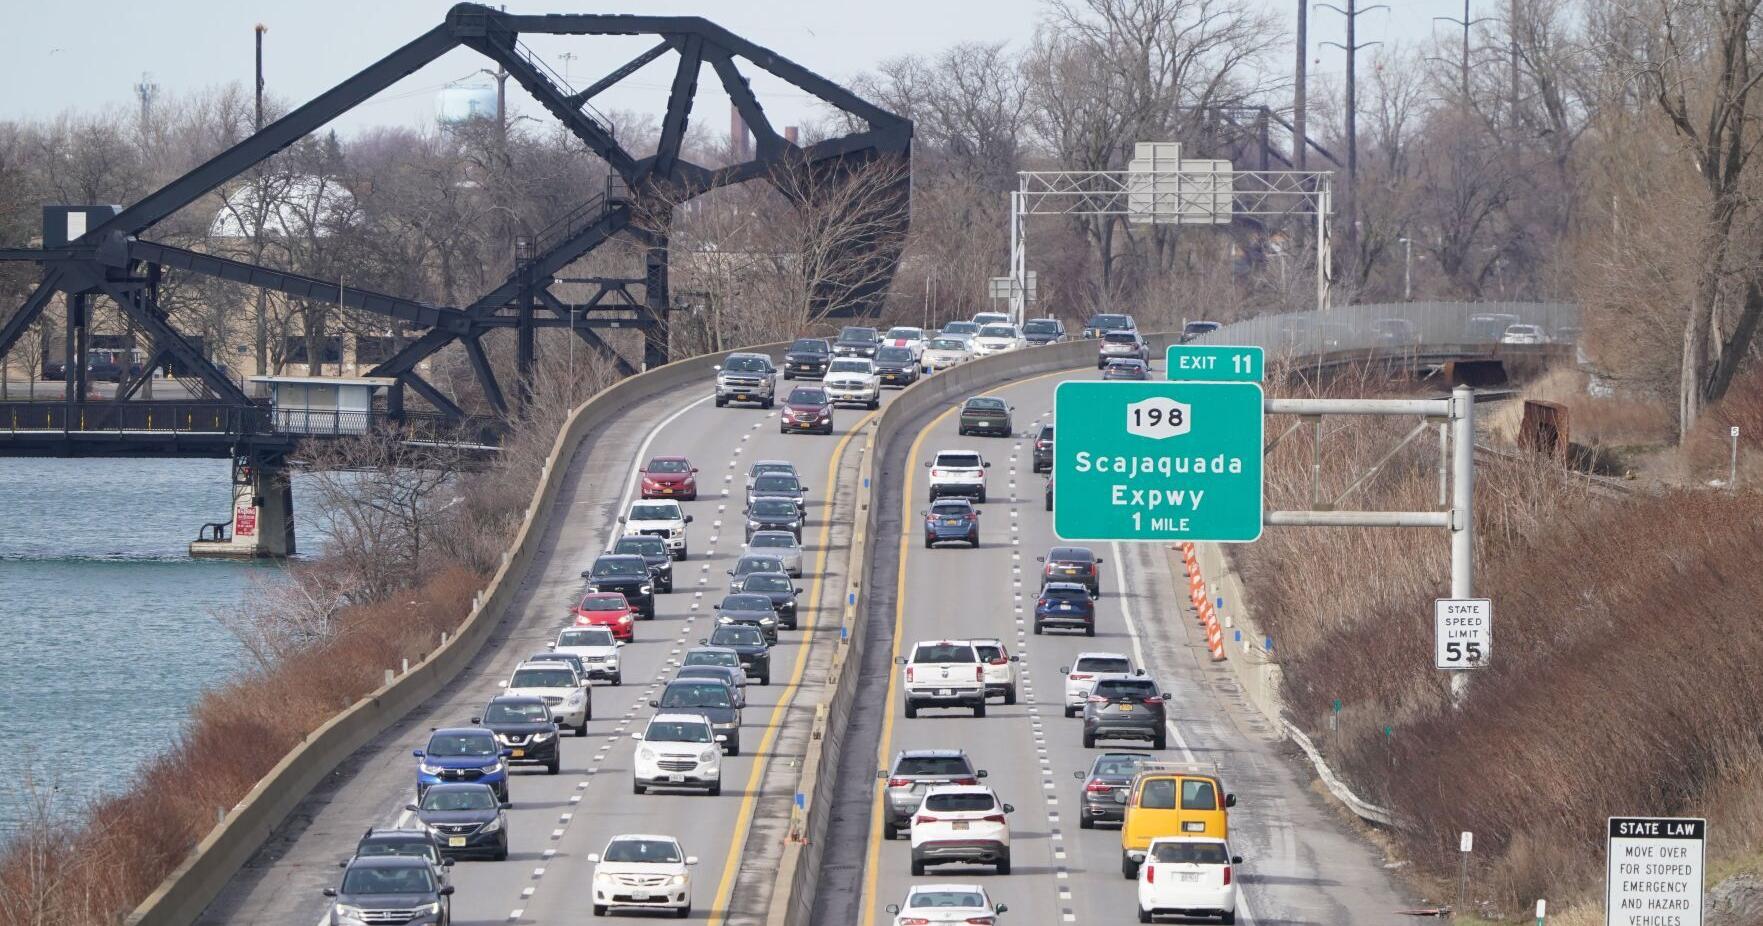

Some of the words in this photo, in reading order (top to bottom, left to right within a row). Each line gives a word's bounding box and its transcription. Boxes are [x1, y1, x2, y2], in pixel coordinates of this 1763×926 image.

[1180, 356, 1216, 370] EXIT
[1232, 354, 1252, 374] 11
[1134, 408, 1183, 426] 198
[1075, 452, 1242, 478] Scajaquada
[1112, 485, 1204, 510] Expwy
[1132, 512, 1141, 530] 1
[1152, 518, 1190, 532] MILE
[1448, 606, 1479, 614] STATE
[1446, 642, 1482, 662] 55
[1620, 822, 1659, 834] STATE
[1668, 824, 1695, 835] LAW
[1626, 846, 1654, 858] MOVE
[1660, 847, 1688, 858] OVER
[1620, 864, 1640, 874] FOR
[1646, 864, 1692, 876] STOPPED
[1623, 881, 1688, 892] EMERGENCY
[1622, 898, 1642, 910] AND
[1648, 898, 1690, 910] HAZARD
[1630, 916, 1681, 926] VEHICLES
